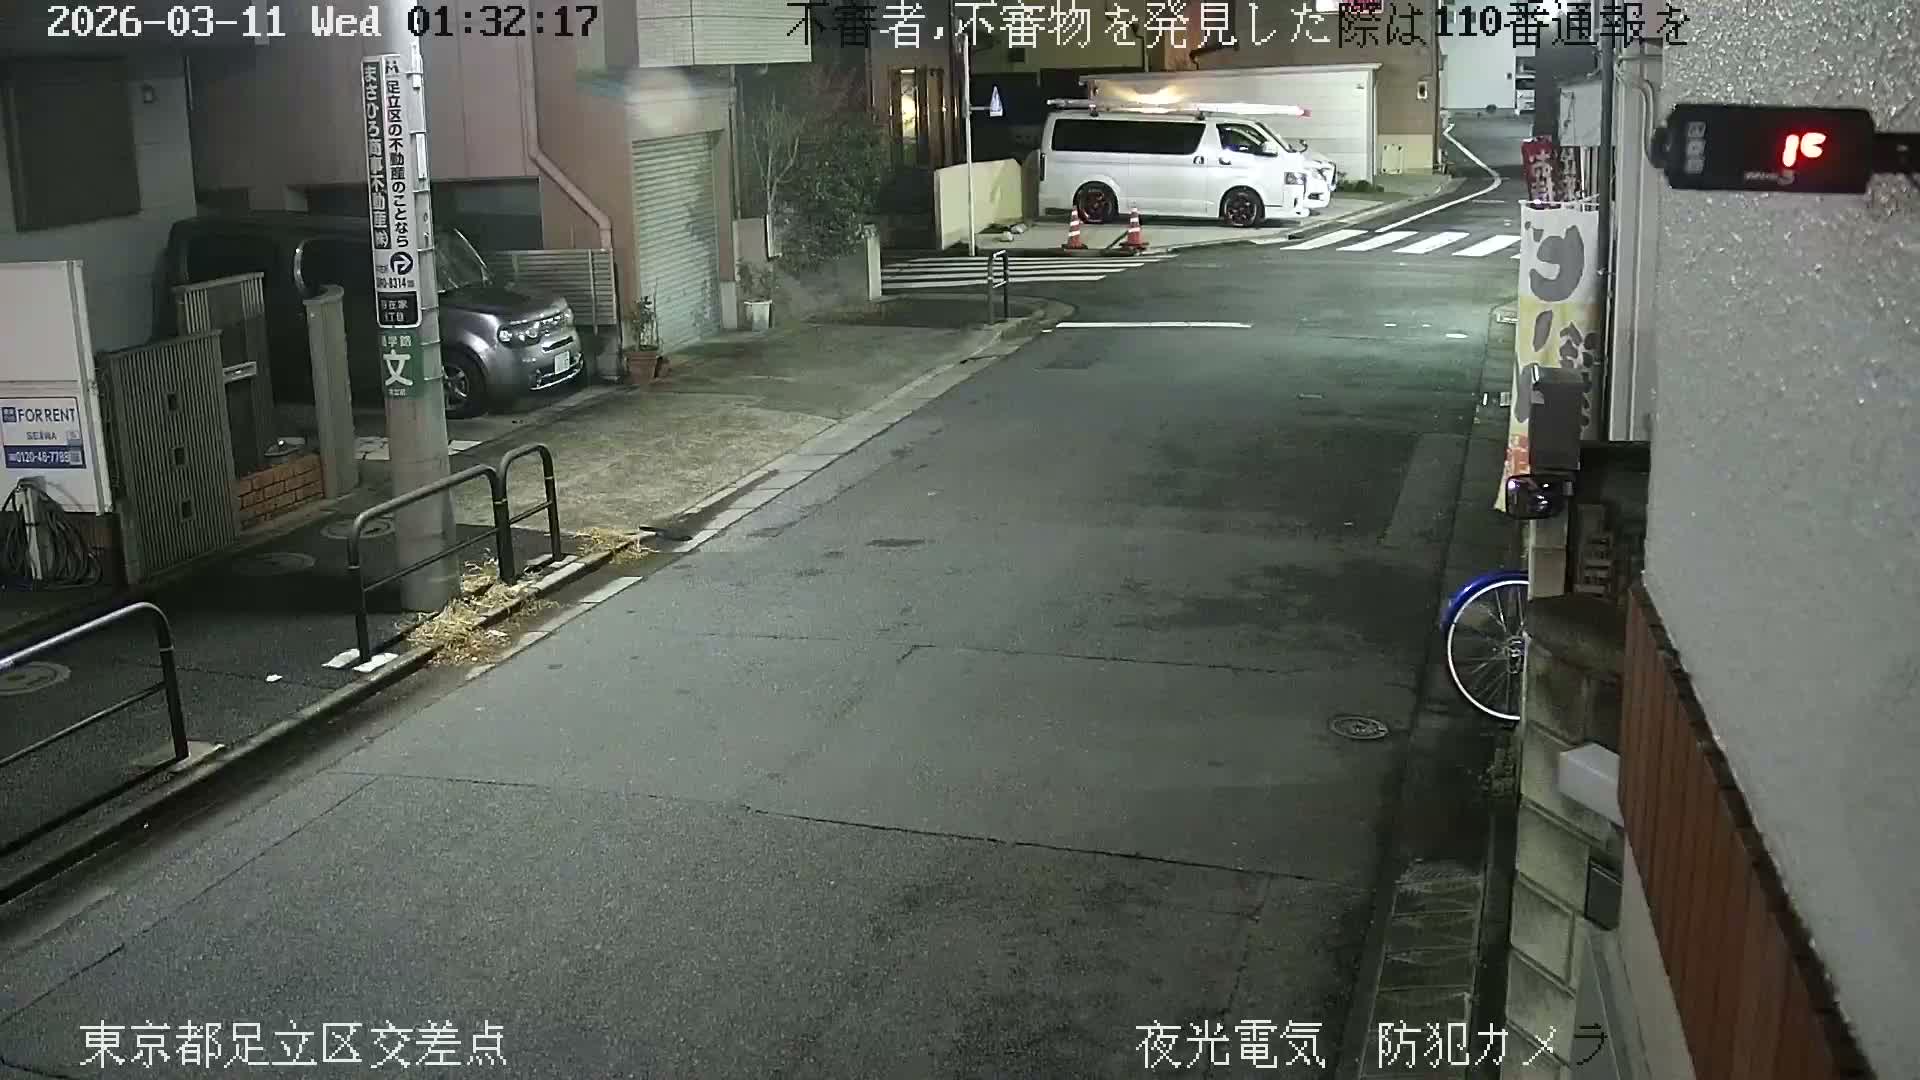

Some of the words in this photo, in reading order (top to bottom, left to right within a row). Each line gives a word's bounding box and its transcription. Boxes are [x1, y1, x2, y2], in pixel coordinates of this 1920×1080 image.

[382, 349, 413, 386] 文
[17, 408, 43, 422] FOR
[44, 407, 75, 422] RENT
